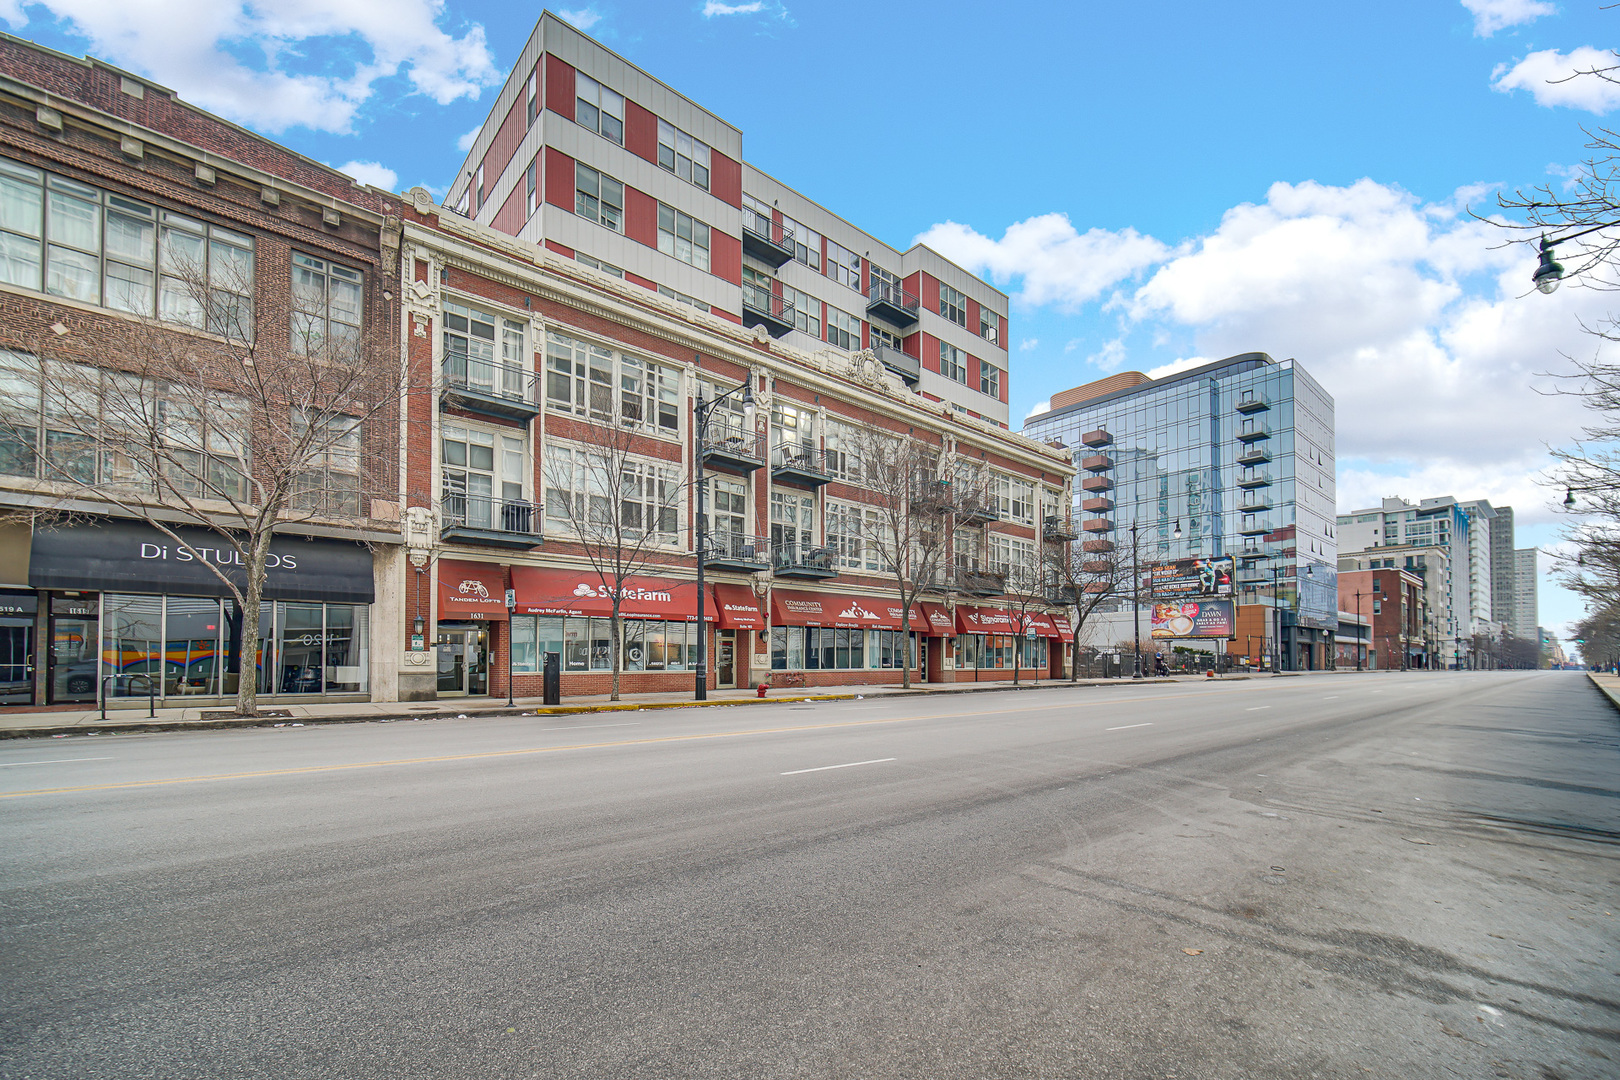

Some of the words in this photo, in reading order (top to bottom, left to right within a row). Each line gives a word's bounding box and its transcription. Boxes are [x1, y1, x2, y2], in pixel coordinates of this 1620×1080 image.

[141, 543, 168, 560] Di
[176, 546, 297, 569] STUOS
[598, 585, 672, 602] StteFarm
[731, 604, 758, 612] StateFarm
